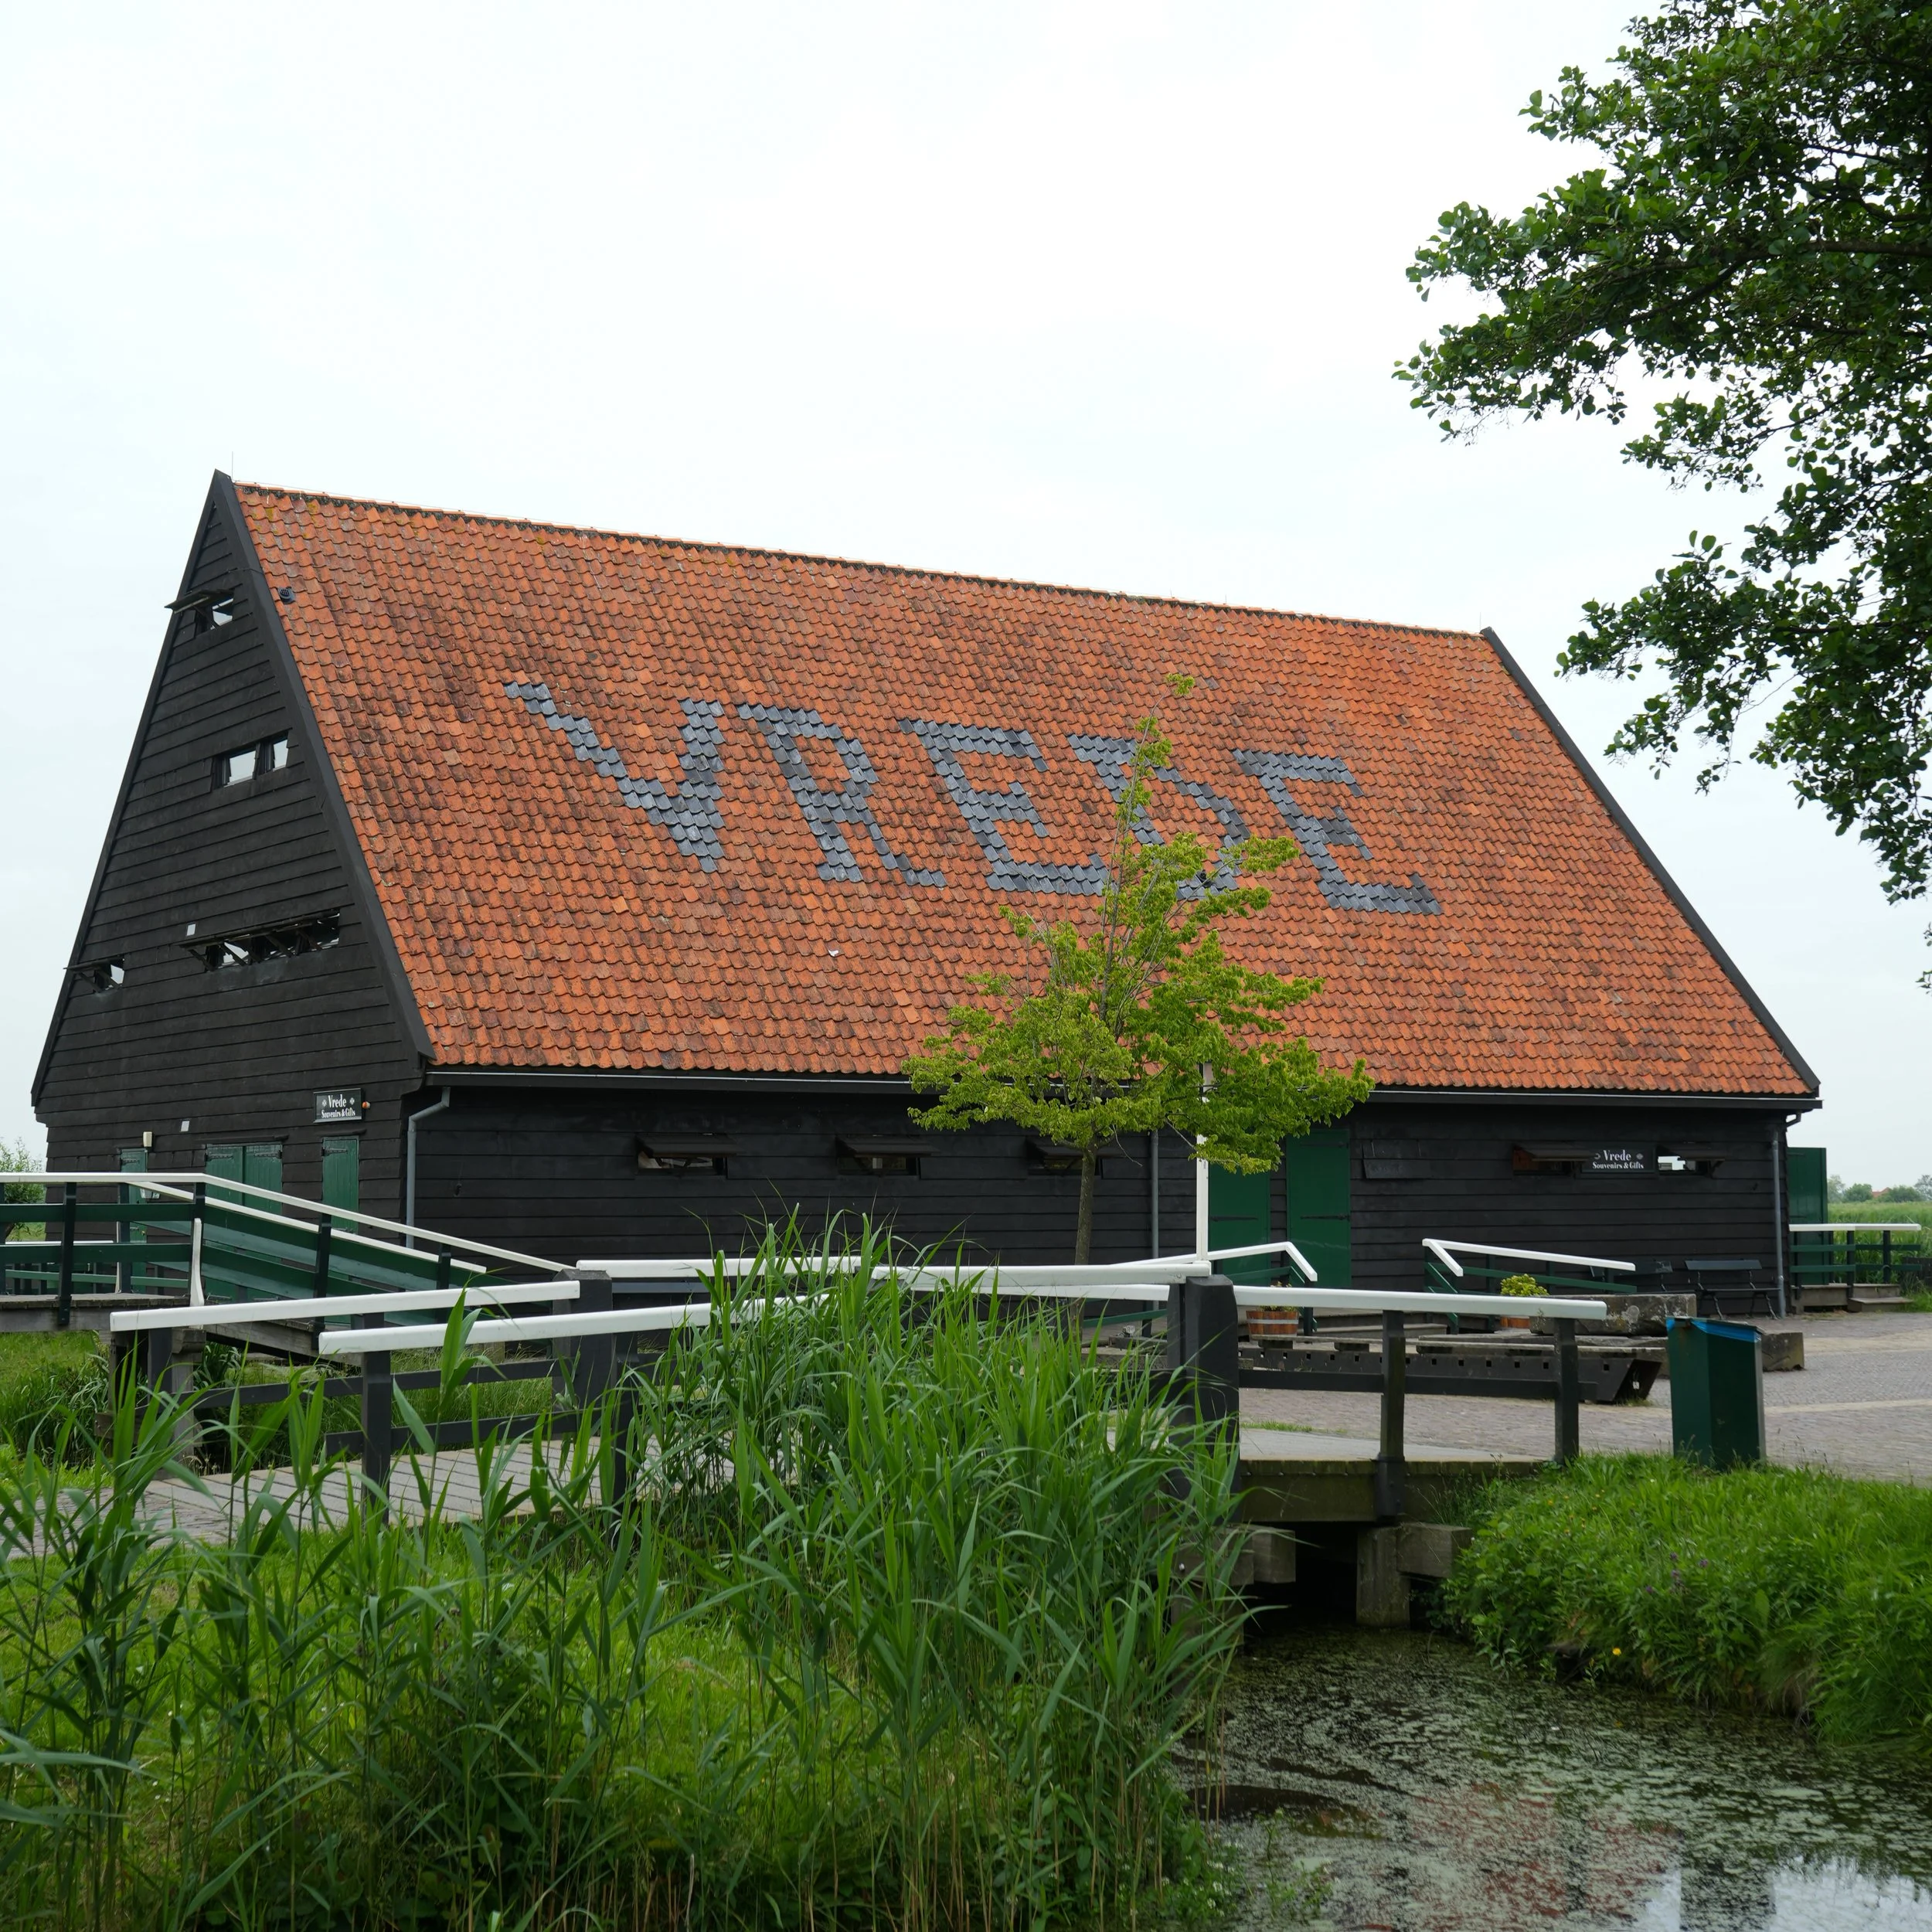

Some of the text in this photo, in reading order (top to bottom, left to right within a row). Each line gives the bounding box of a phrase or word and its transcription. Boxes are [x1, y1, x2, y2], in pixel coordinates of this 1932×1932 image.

[504, 682, 1443, 915] VREDE
[328, 1094, 347, 1108] Vrede
[321, 1107, 355, 1118] Souvenirs & Gifts
[1603, 1149, 1631, 1161] Vrede
[1629, 1161, 1645, 1169] Gifts
